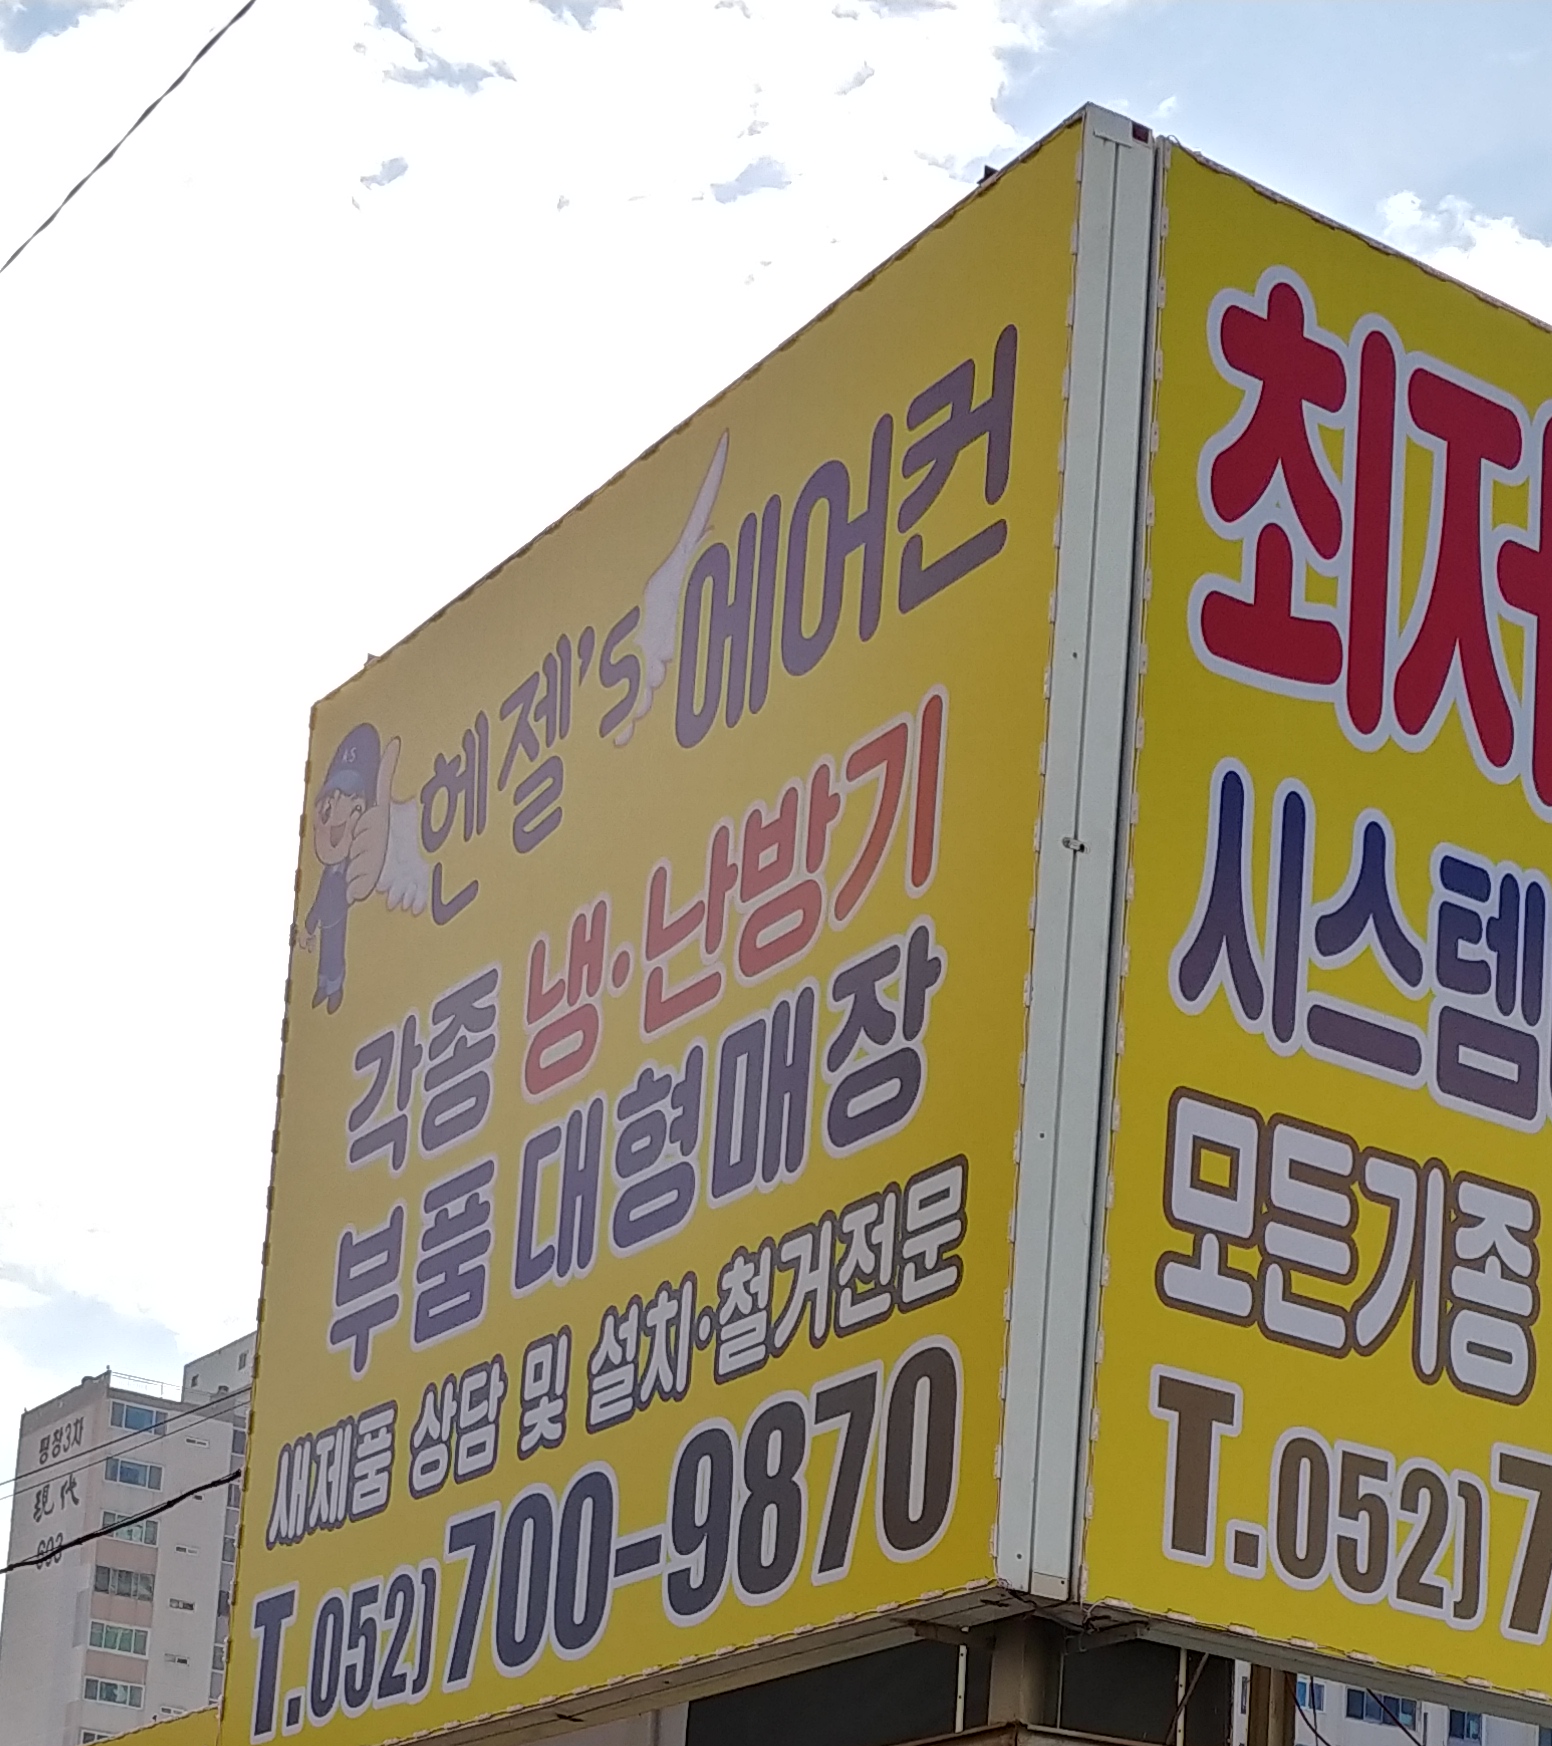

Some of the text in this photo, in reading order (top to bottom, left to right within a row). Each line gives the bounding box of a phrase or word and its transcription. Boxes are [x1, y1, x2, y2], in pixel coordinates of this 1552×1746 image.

[674, 323, 1019, 749] 에어컨
[346, 966, 499, 1171] 각종
[328, 1158, 498, 1382] 부품
[1154, 1084, 1540, 1405] 모든기종
[266, 1401, 398, 1549] 새제품
[409, 1354, 508, 1500] 상담
[517, 1325, 572, 1461] 및
